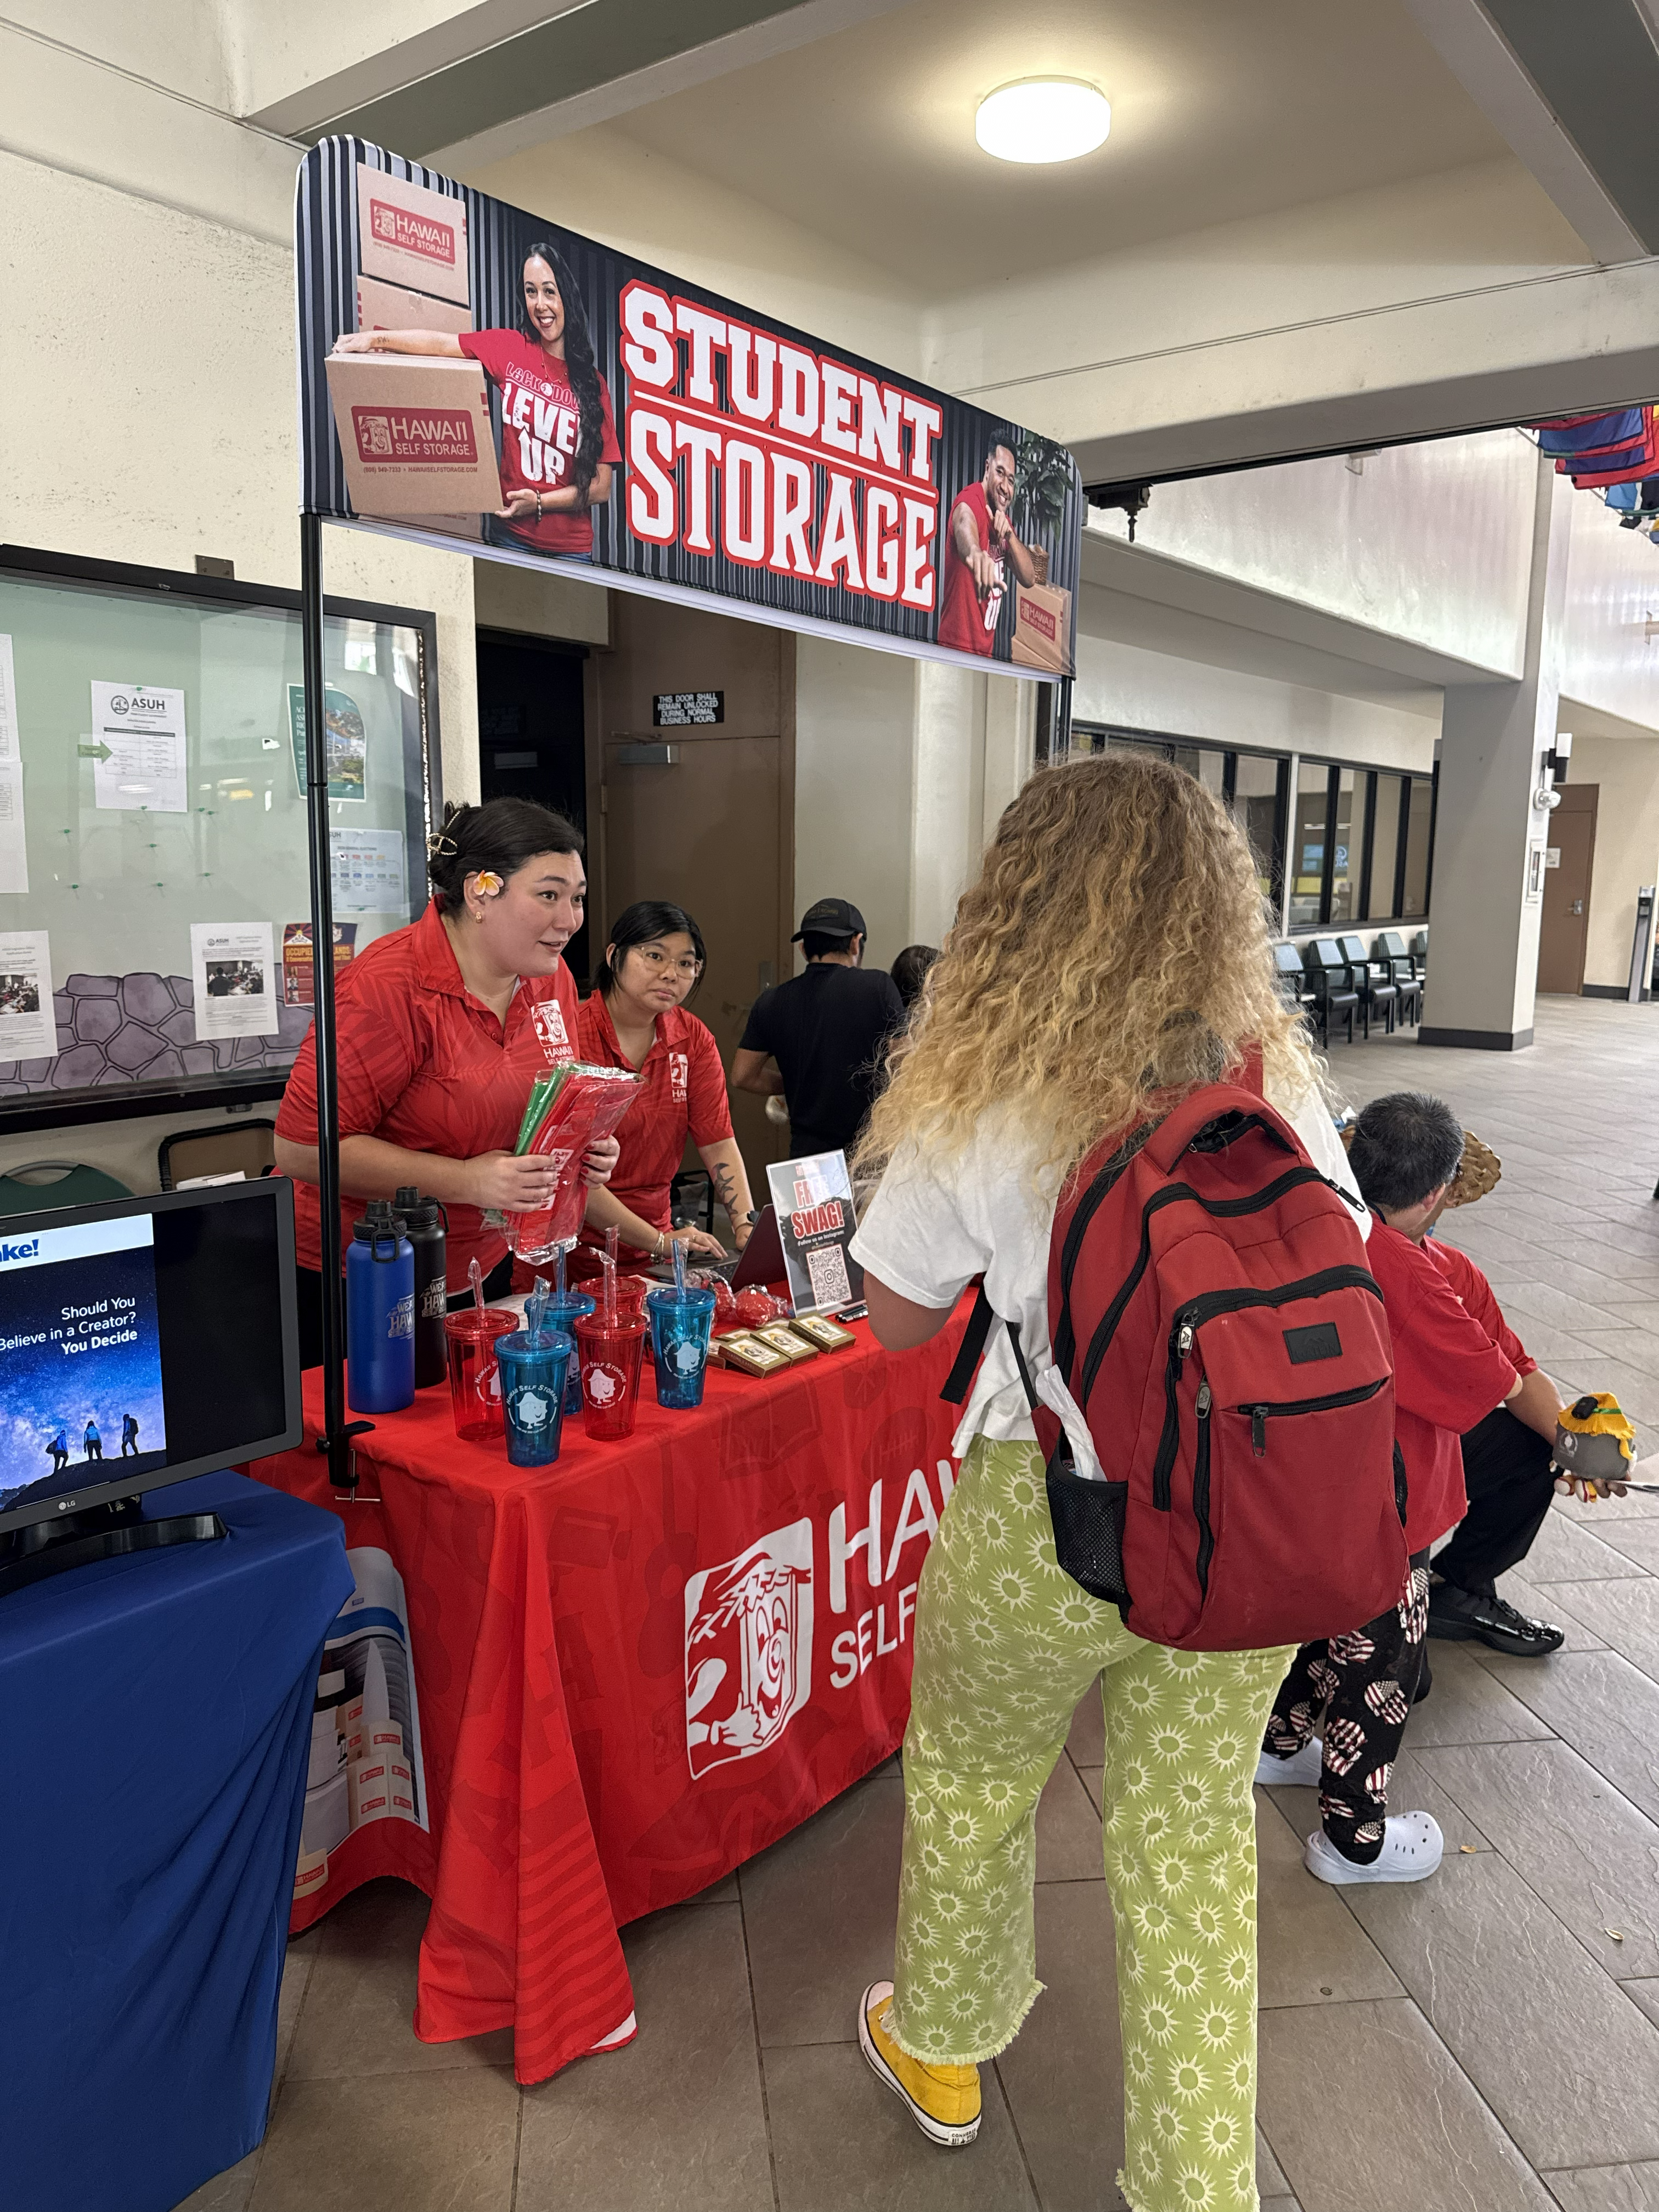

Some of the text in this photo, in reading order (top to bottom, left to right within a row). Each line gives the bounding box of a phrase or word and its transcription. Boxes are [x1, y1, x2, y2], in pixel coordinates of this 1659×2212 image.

[397, 233, 415, 246] SELF
[417, 239, 450, 258] STORAGE
[623, 285, 941, 482] STUDENT
[395, 442, 470, 456] SELF STORAGE
[518, 426, 565, 485] UP
[629, 408, 938, 608] STORAGE
[131, 697, 165, 710] ASUH
[658, 700, 719, 711] REMAIN UNLOCKED
[659, 692, 717, 704] THIS DOOR SHALL
[660, 715, 716, 725] BUSINESS HOURS
[661, 708, 715, 718] DURING NORMAL
[791, 1200, 845, 1239] SWAG!
[0, 1238, 40, 1262] ke!
[61, 1297, 136, 1321] Should You
[0, 1311, 136, 1351] Believe in a Creator?
[61, 1329, 138, 1355] You Decide
[605, 1363, 627, 1383] STORAGE
[538, 1384, 558, 1404] STORAGE
[828, 1459, 957, 1614] HA
[830, 1581, 918, 1689] SELF
